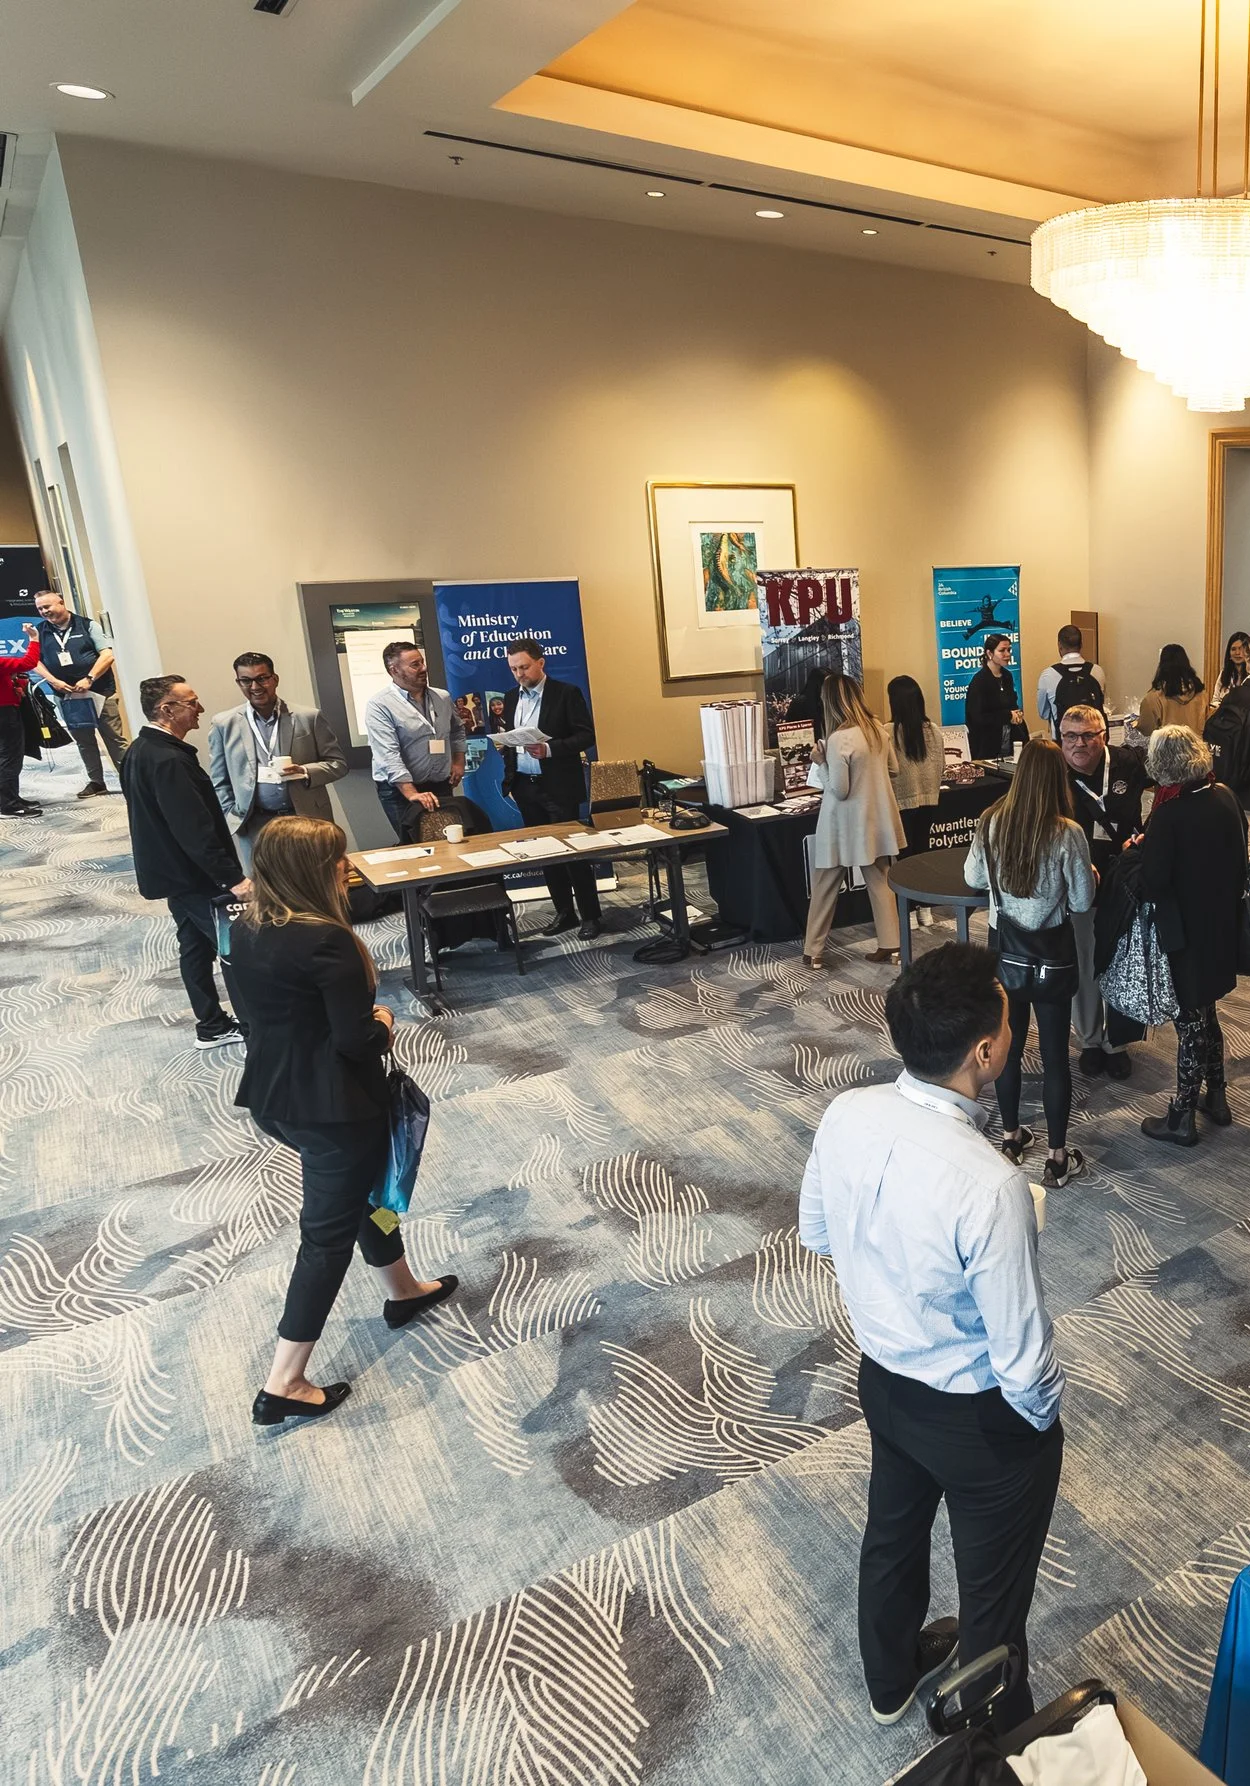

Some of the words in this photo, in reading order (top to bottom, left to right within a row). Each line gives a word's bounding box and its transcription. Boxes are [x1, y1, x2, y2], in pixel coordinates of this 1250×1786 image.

[766, 578, 852, 626] KPU
[458, 614, 519, 628] Ministry
[940, 620, 972, 628] BELIEVE
[460, 631, 478, 647] of
[480, 628, 552, 643] Education
[464, 648, 490, 660] and
[942, 646, 984, 659] BOUND
[929, 830, 976, 848] Polytech
